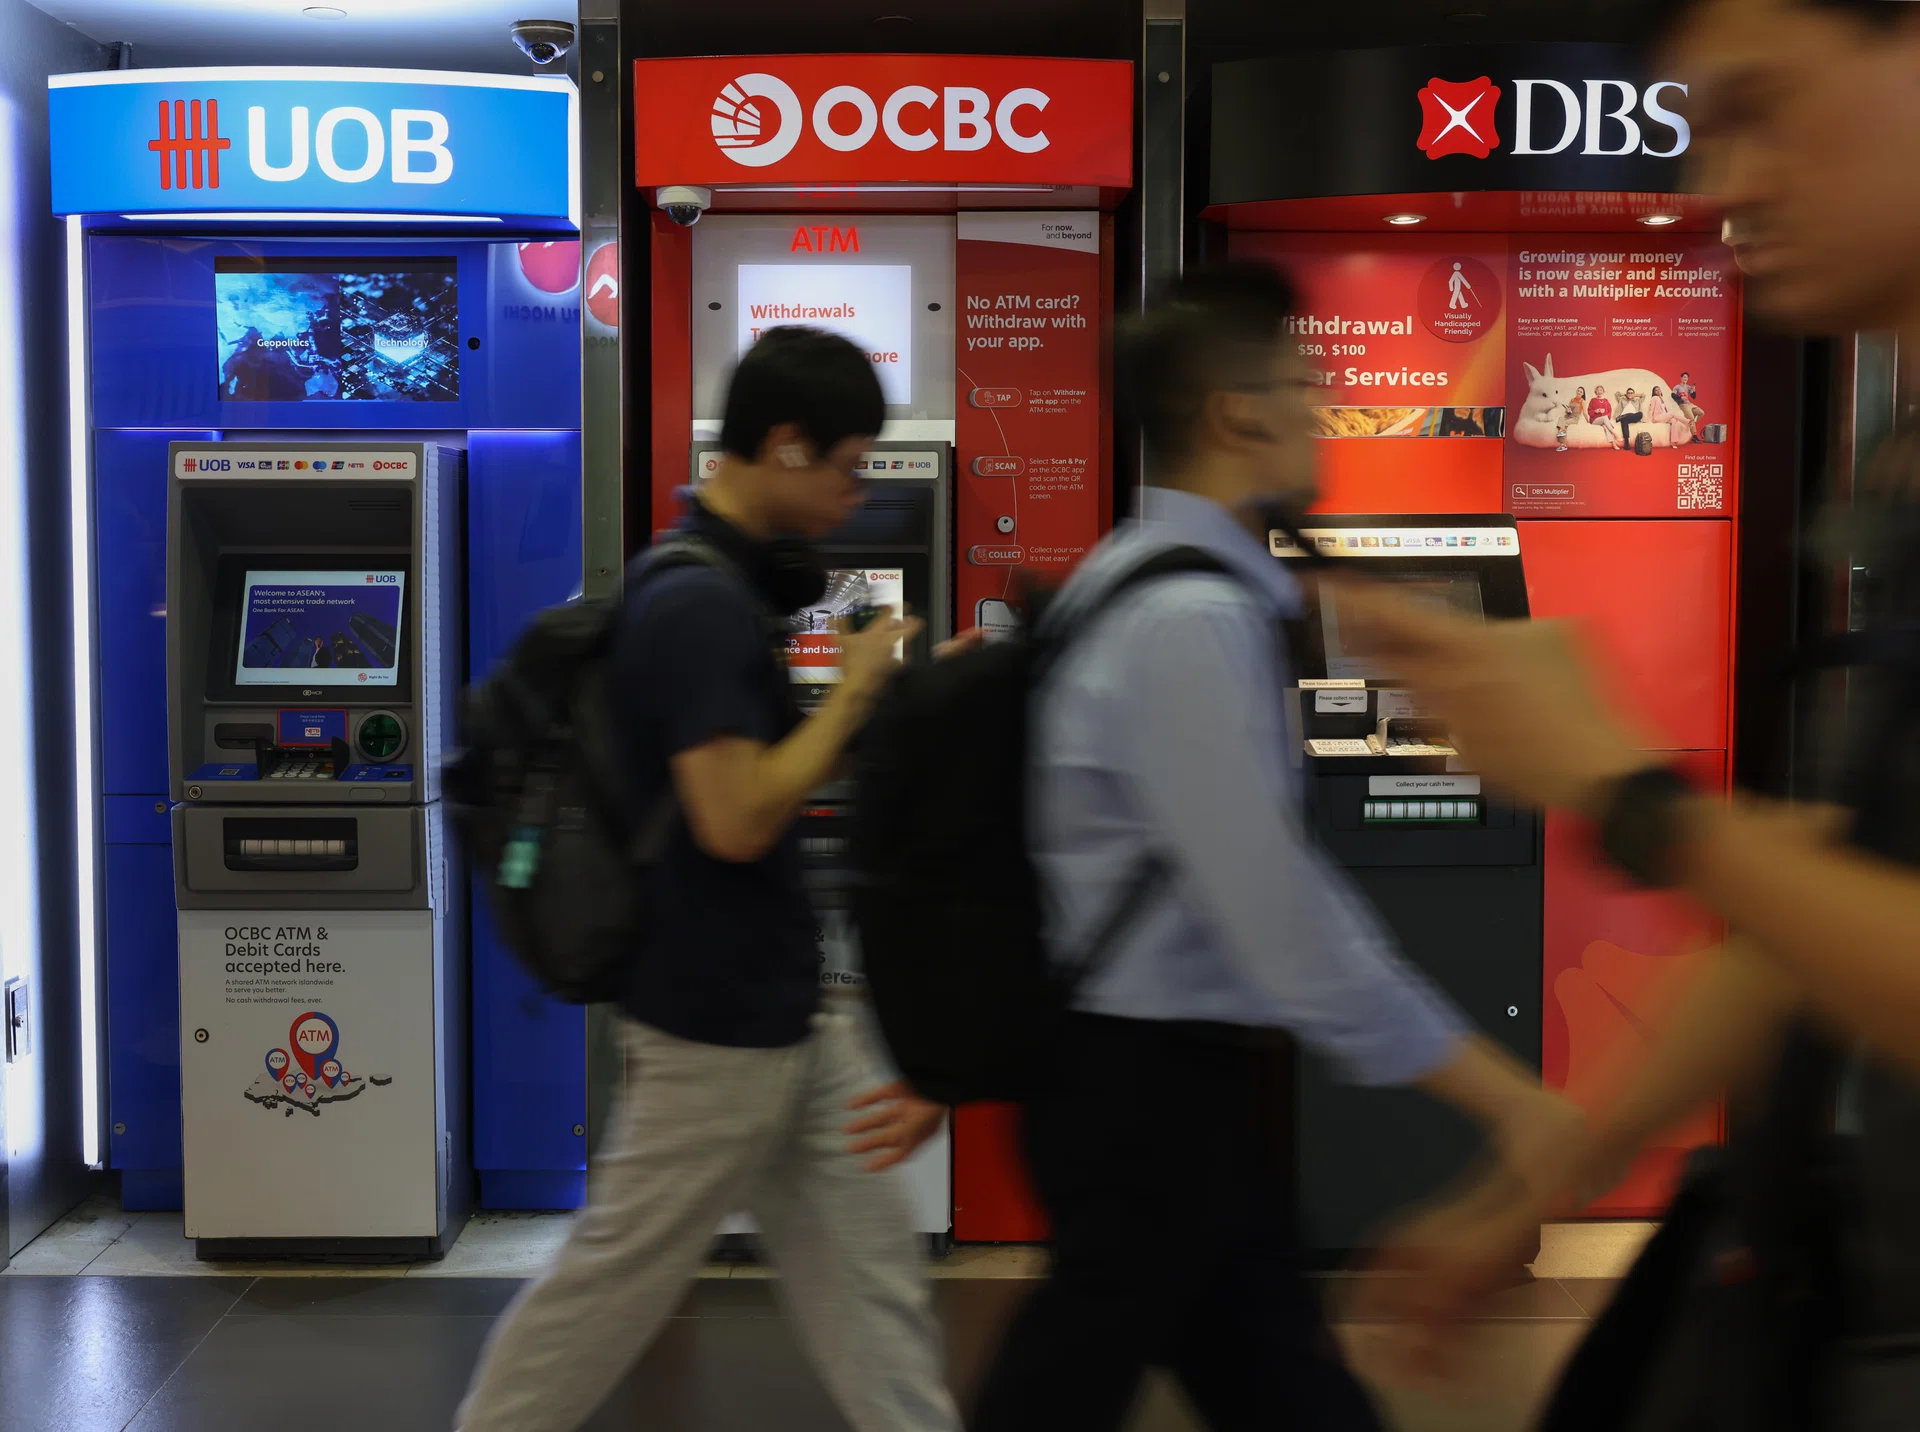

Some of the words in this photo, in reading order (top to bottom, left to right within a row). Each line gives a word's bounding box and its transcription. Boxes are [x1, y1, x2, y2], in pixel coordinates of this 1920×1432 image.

[812, 85, 1051, 153] OCBC
[1510, 79, 1690, 157] DBS
[248, 106, 454, 185] UOB
[1042, 224, 1053, 232] For
[1055, 224, 1074, 232] now,
[791, 226, 860, 253] ATM
[1062, 232, 1092, 240] beyond
[1519, 250, 1585, 266] Growing
[1589, 253, 1625, 266] your
[1630, 253, 1683, 266] money
[1519, 267, 1532, 281] is
[1536, 270, 1569, 281] now
[1574, 267, 1622, 281] easier
[1626, 267, 1656, 281] and
[1660, 267, 1723, 283] simpler,
[1519, 284, 1554, 298] with
[1559, 287, 1568, 298] a
[1573, 284, 1650, 301] Multiplier
[1654, 285, 1723, 298] Account.
[967, 296, 990, 309] No
[995, 296, 1031, 309] ATM
[1036, 295, 1080, 309] card?
[750, 303, 855, 319] Withdrawals
[967, 314, 1046, 329] Withdraw
[1052, 314, 1086, 328] with
[1434, 320, 1481, 328] Handicapped
[1445, 328, 1472, 336] Friendly
[257, 339, 309, 349] Geopolitics
[375, 339, 429, 349] Technology
[967, 337, 1004, 351] your
[1008, 337, 1044, 351] app.
[1298, 344, 1327, 357] $50,
[1332, 344, 1366, 357] $100
[1344, 367, 1448, 386] Services
[200, 460, 231, 472] UOB
[383, 462, 408, 470] OCBC
[376, 575, 396, 583] UOB
[803, 646, 820, 654] and
[224, 927, 271, 940] OCBC
[275, 927, 312, 940] ATM
[317, 927, 328, 940] &
[225, 943, 269, 957] Debit
[274, 943, 321, 957] Cards
[225, 959, 301, 976] accepted
[306, 959, 346, 973] here.
[818, 972, 857, 984] ere.
[299, 1030, 330, 1042] ATM
